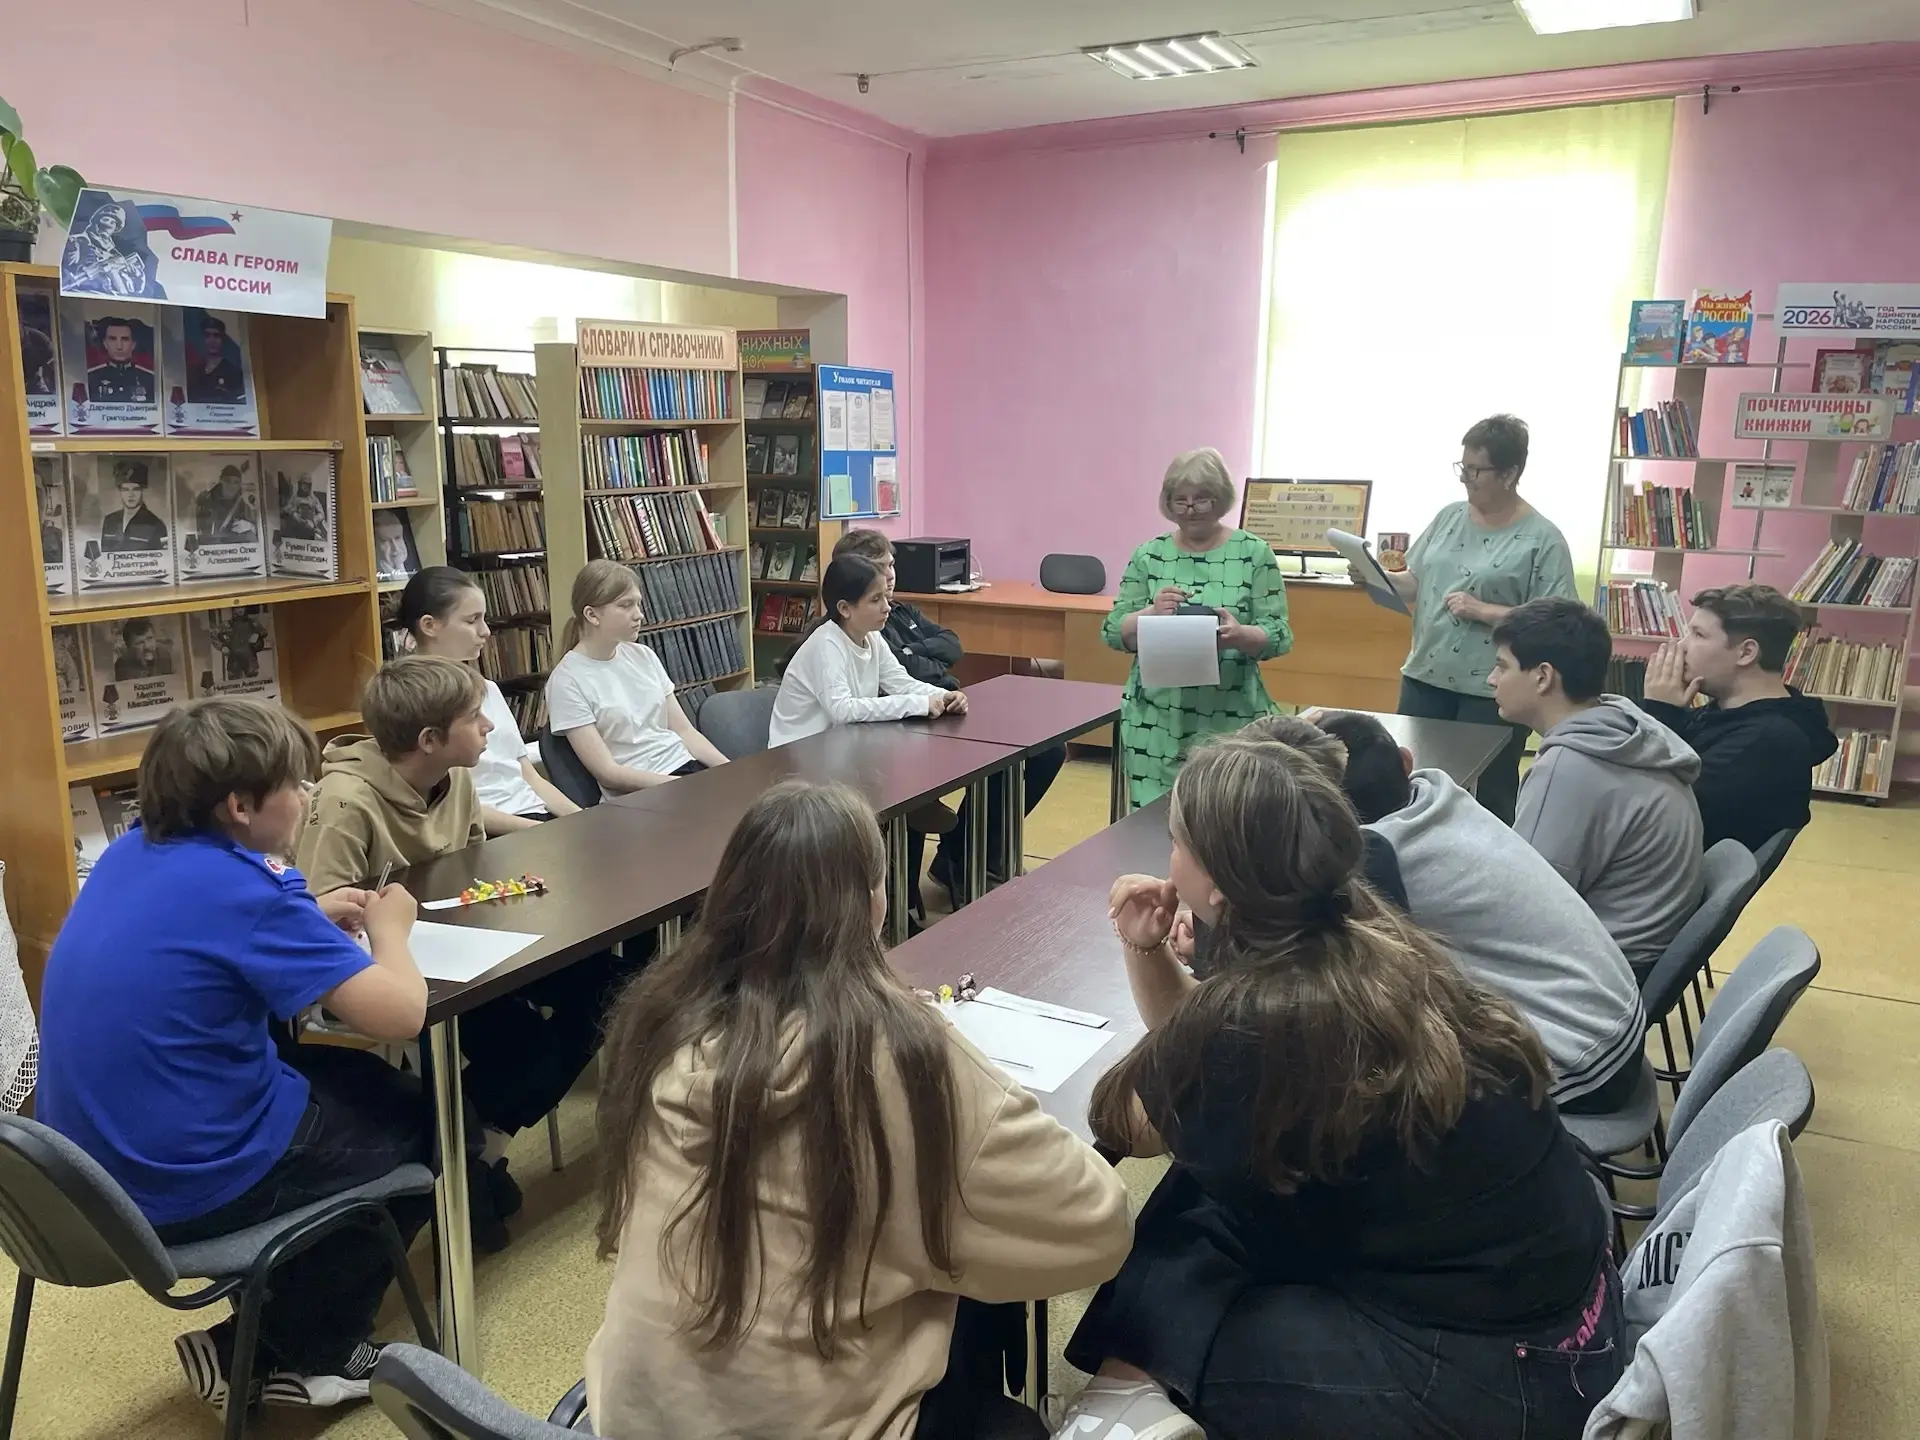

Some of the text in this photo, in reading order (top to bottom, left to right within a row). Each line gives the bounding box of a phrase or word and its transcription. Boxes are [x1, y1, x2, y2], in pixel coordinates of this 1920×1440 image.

[171, 246, 299, 274] СЛАВА ГЕРОЯМ
[204, 275, 272, 295] РОССИИ
[1700, 300, 1714, 310] Мы
[1702, 310, 1749, 323] РОССИИ
[1783, 309, 1832, 325] 2026
[582, 328, 724, 360] СЛОВАРИ И СПРАВОЧНИКИ
[743, 354, 766, 370] НОК
[833, 371, 881, 386] Уголок читателя
[126, 404, 158, 412] Дмитрий
[1747, 398, 1872, 414] ПОЧЕМУЧКИНЫ
[1744, 418, 1812, 432] КНИЖКИ
[239, 546, 257, 555] Олег
[44, 564, 64, 572] рилл
[111, 559, 158, 570] Дмитрий
[103, 569, 166, 578] Алексеевич
[783, 616, 802, 626] БУНТ
[61, 722, 90, 734] рович
[1637, 1231, 1692, 1290] MC
